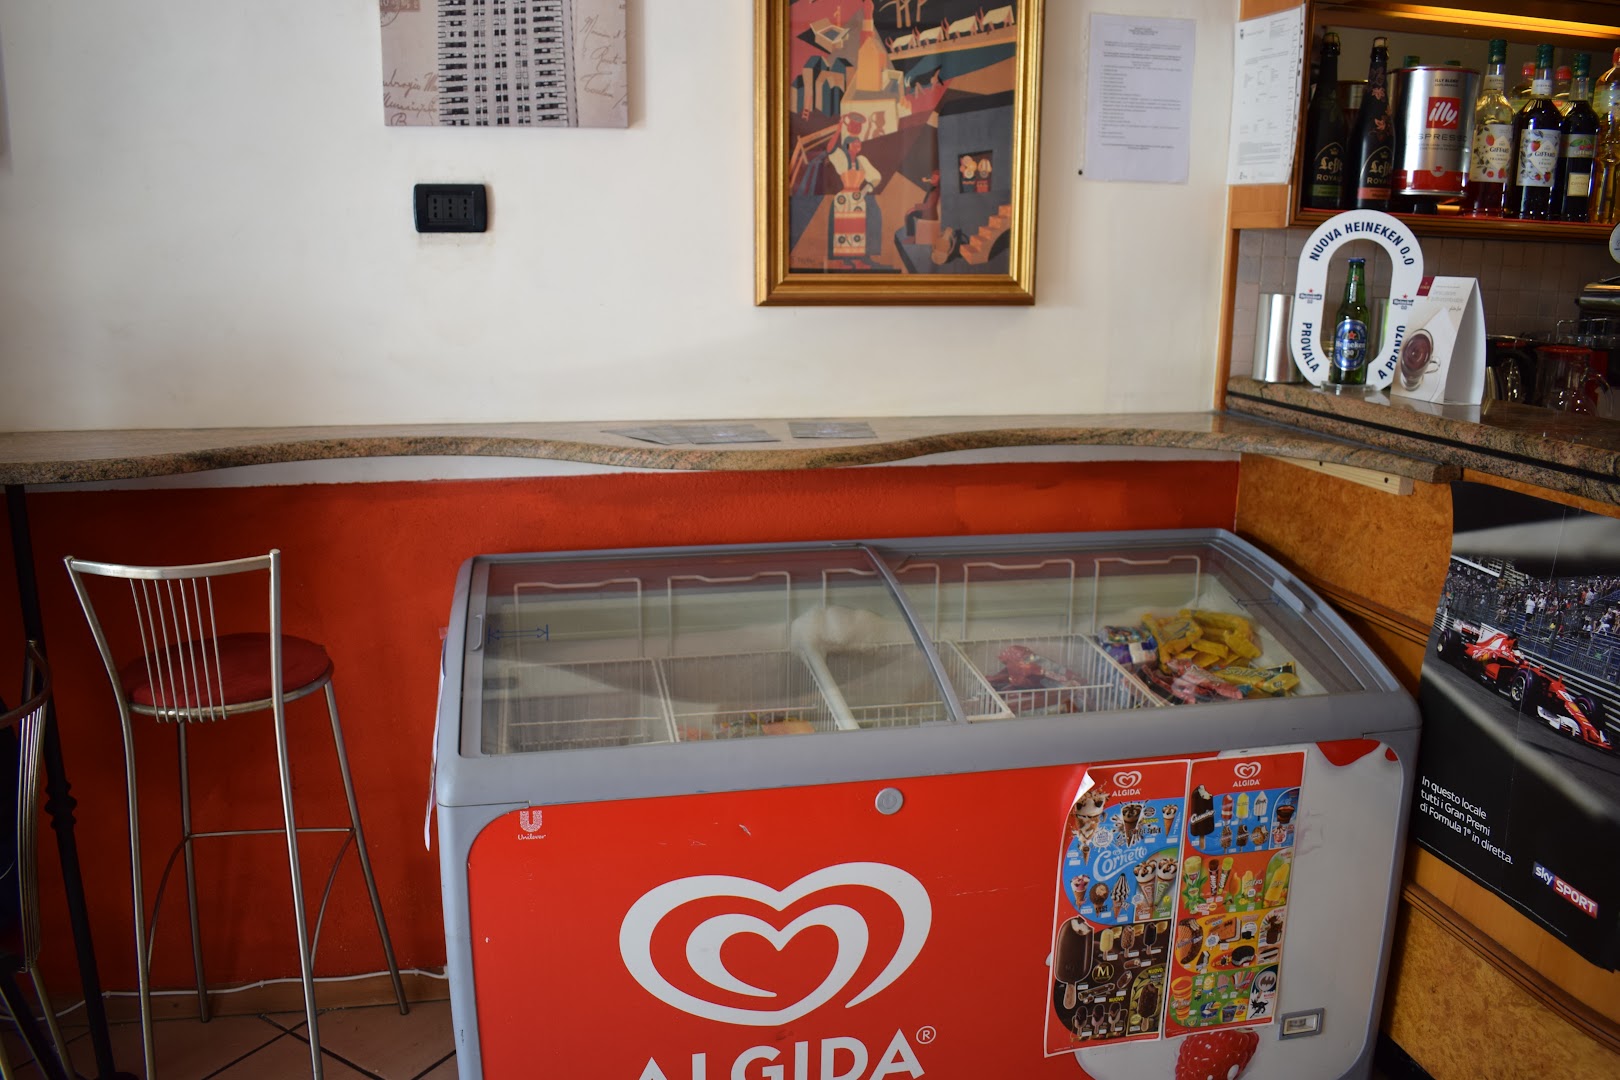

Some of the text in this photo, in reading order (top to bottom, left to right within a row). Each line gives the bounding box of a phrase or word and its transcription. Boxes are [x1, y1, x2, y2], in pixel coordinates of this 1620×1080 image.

[1428, 101, 1458, 126] illy
[1409, 133, 1468, 141] SPRESSO
[1309, 221, 1415, 266] NUOVA HEINEKEN 0.0
[1300, 322, 1320, 373] PROVALA
[1377, 369, 1388, 380] A
[1111, 788, 1142, 797] ALGIDA
[1232, 779, 1260, 788] ALGIDA
[1421, 775, 1487, 820] In questo locale
[1421, 789, 1440, 807] tutti
[1444, 802, 1465, 822] Gran
[1466, 815, 1491, 836] Premi
[1420, 802, 1428, 813] di
[1428, 806, 1462, 834] Formula
[1471, 831, 1480, 845] in
[1481, 838, 1513, 865] diretta.
[1093, 846, 1148, 881] Cornetto
[1535, 866, 1596, 913] sky SPORT
